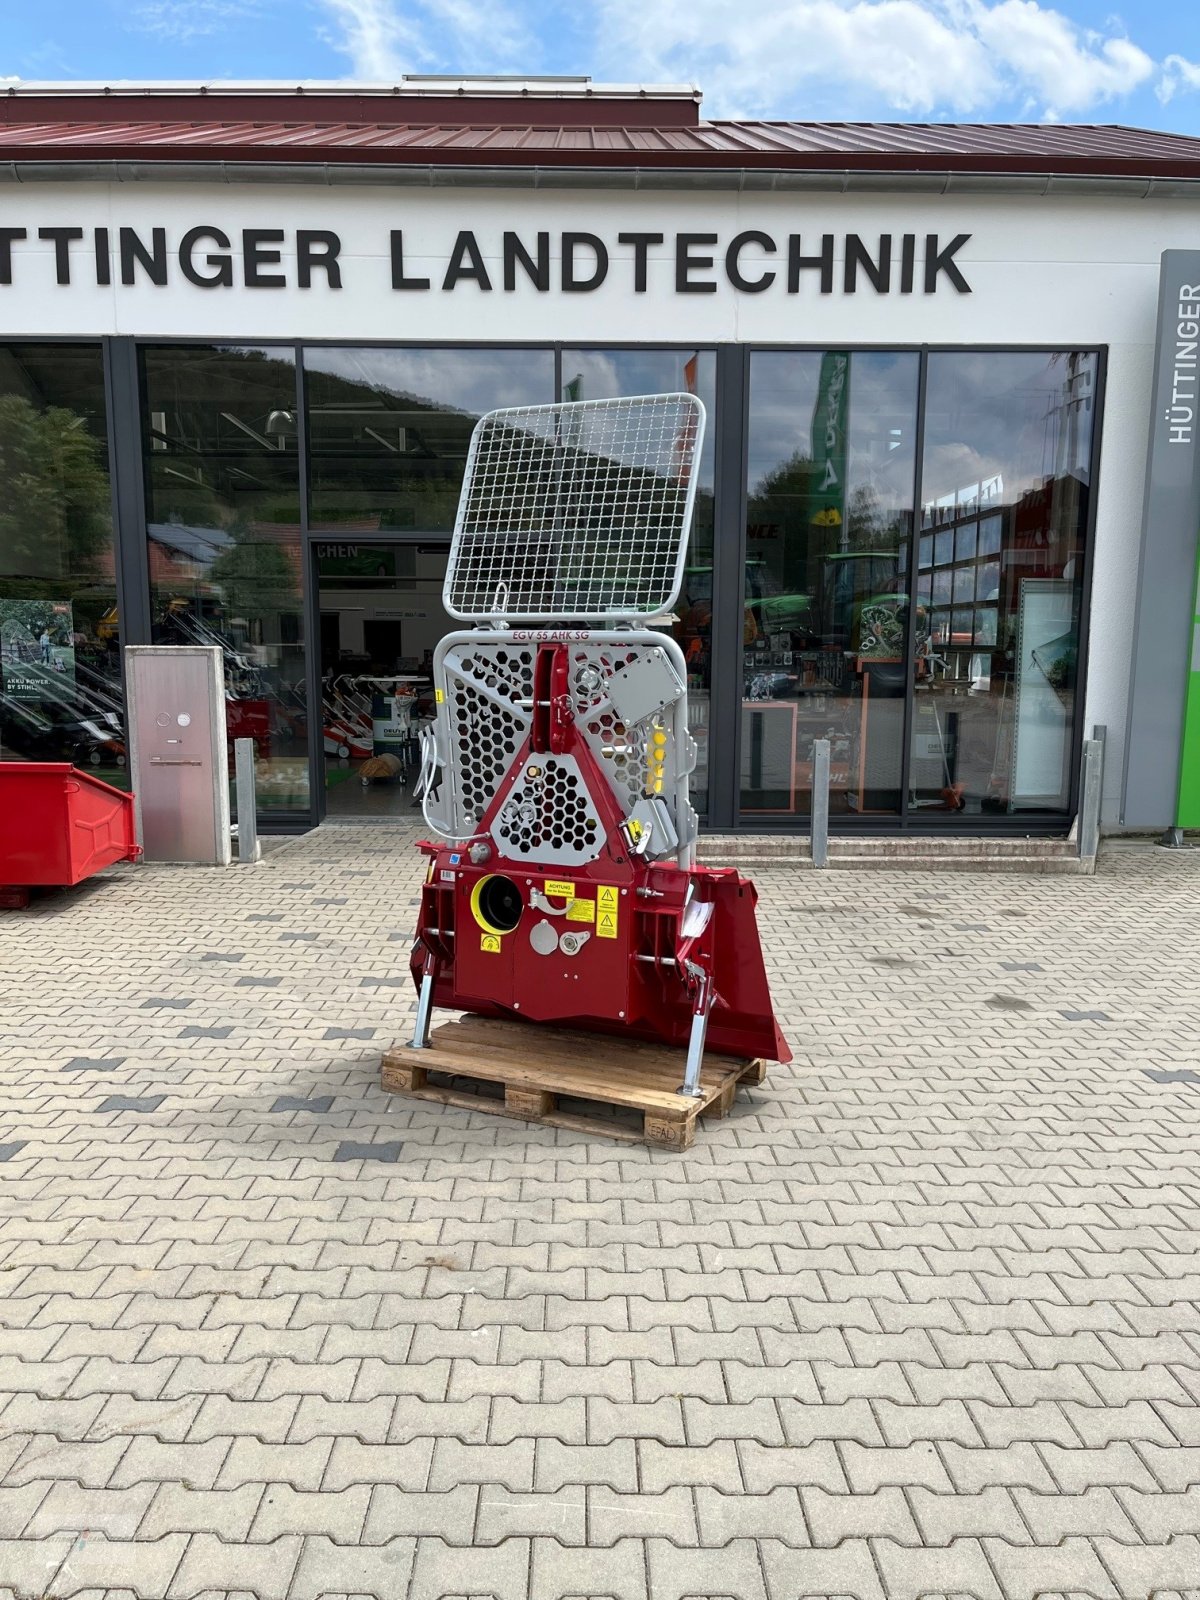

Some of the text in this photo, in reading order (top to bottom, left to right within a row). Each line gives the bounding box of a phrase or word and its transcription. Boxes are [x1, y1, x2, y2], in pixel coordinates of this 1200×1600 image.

[0, 225, 973, 294] TTINGER LANDTECHNIK
[1164, 284, 1200, 443] HÜTTINGER
[317, 545, 358, 558] CHEN
[513, 631, 589, 640] EGV 55 AHK SG
[549, 883, 571, 891] ACHTUNG
